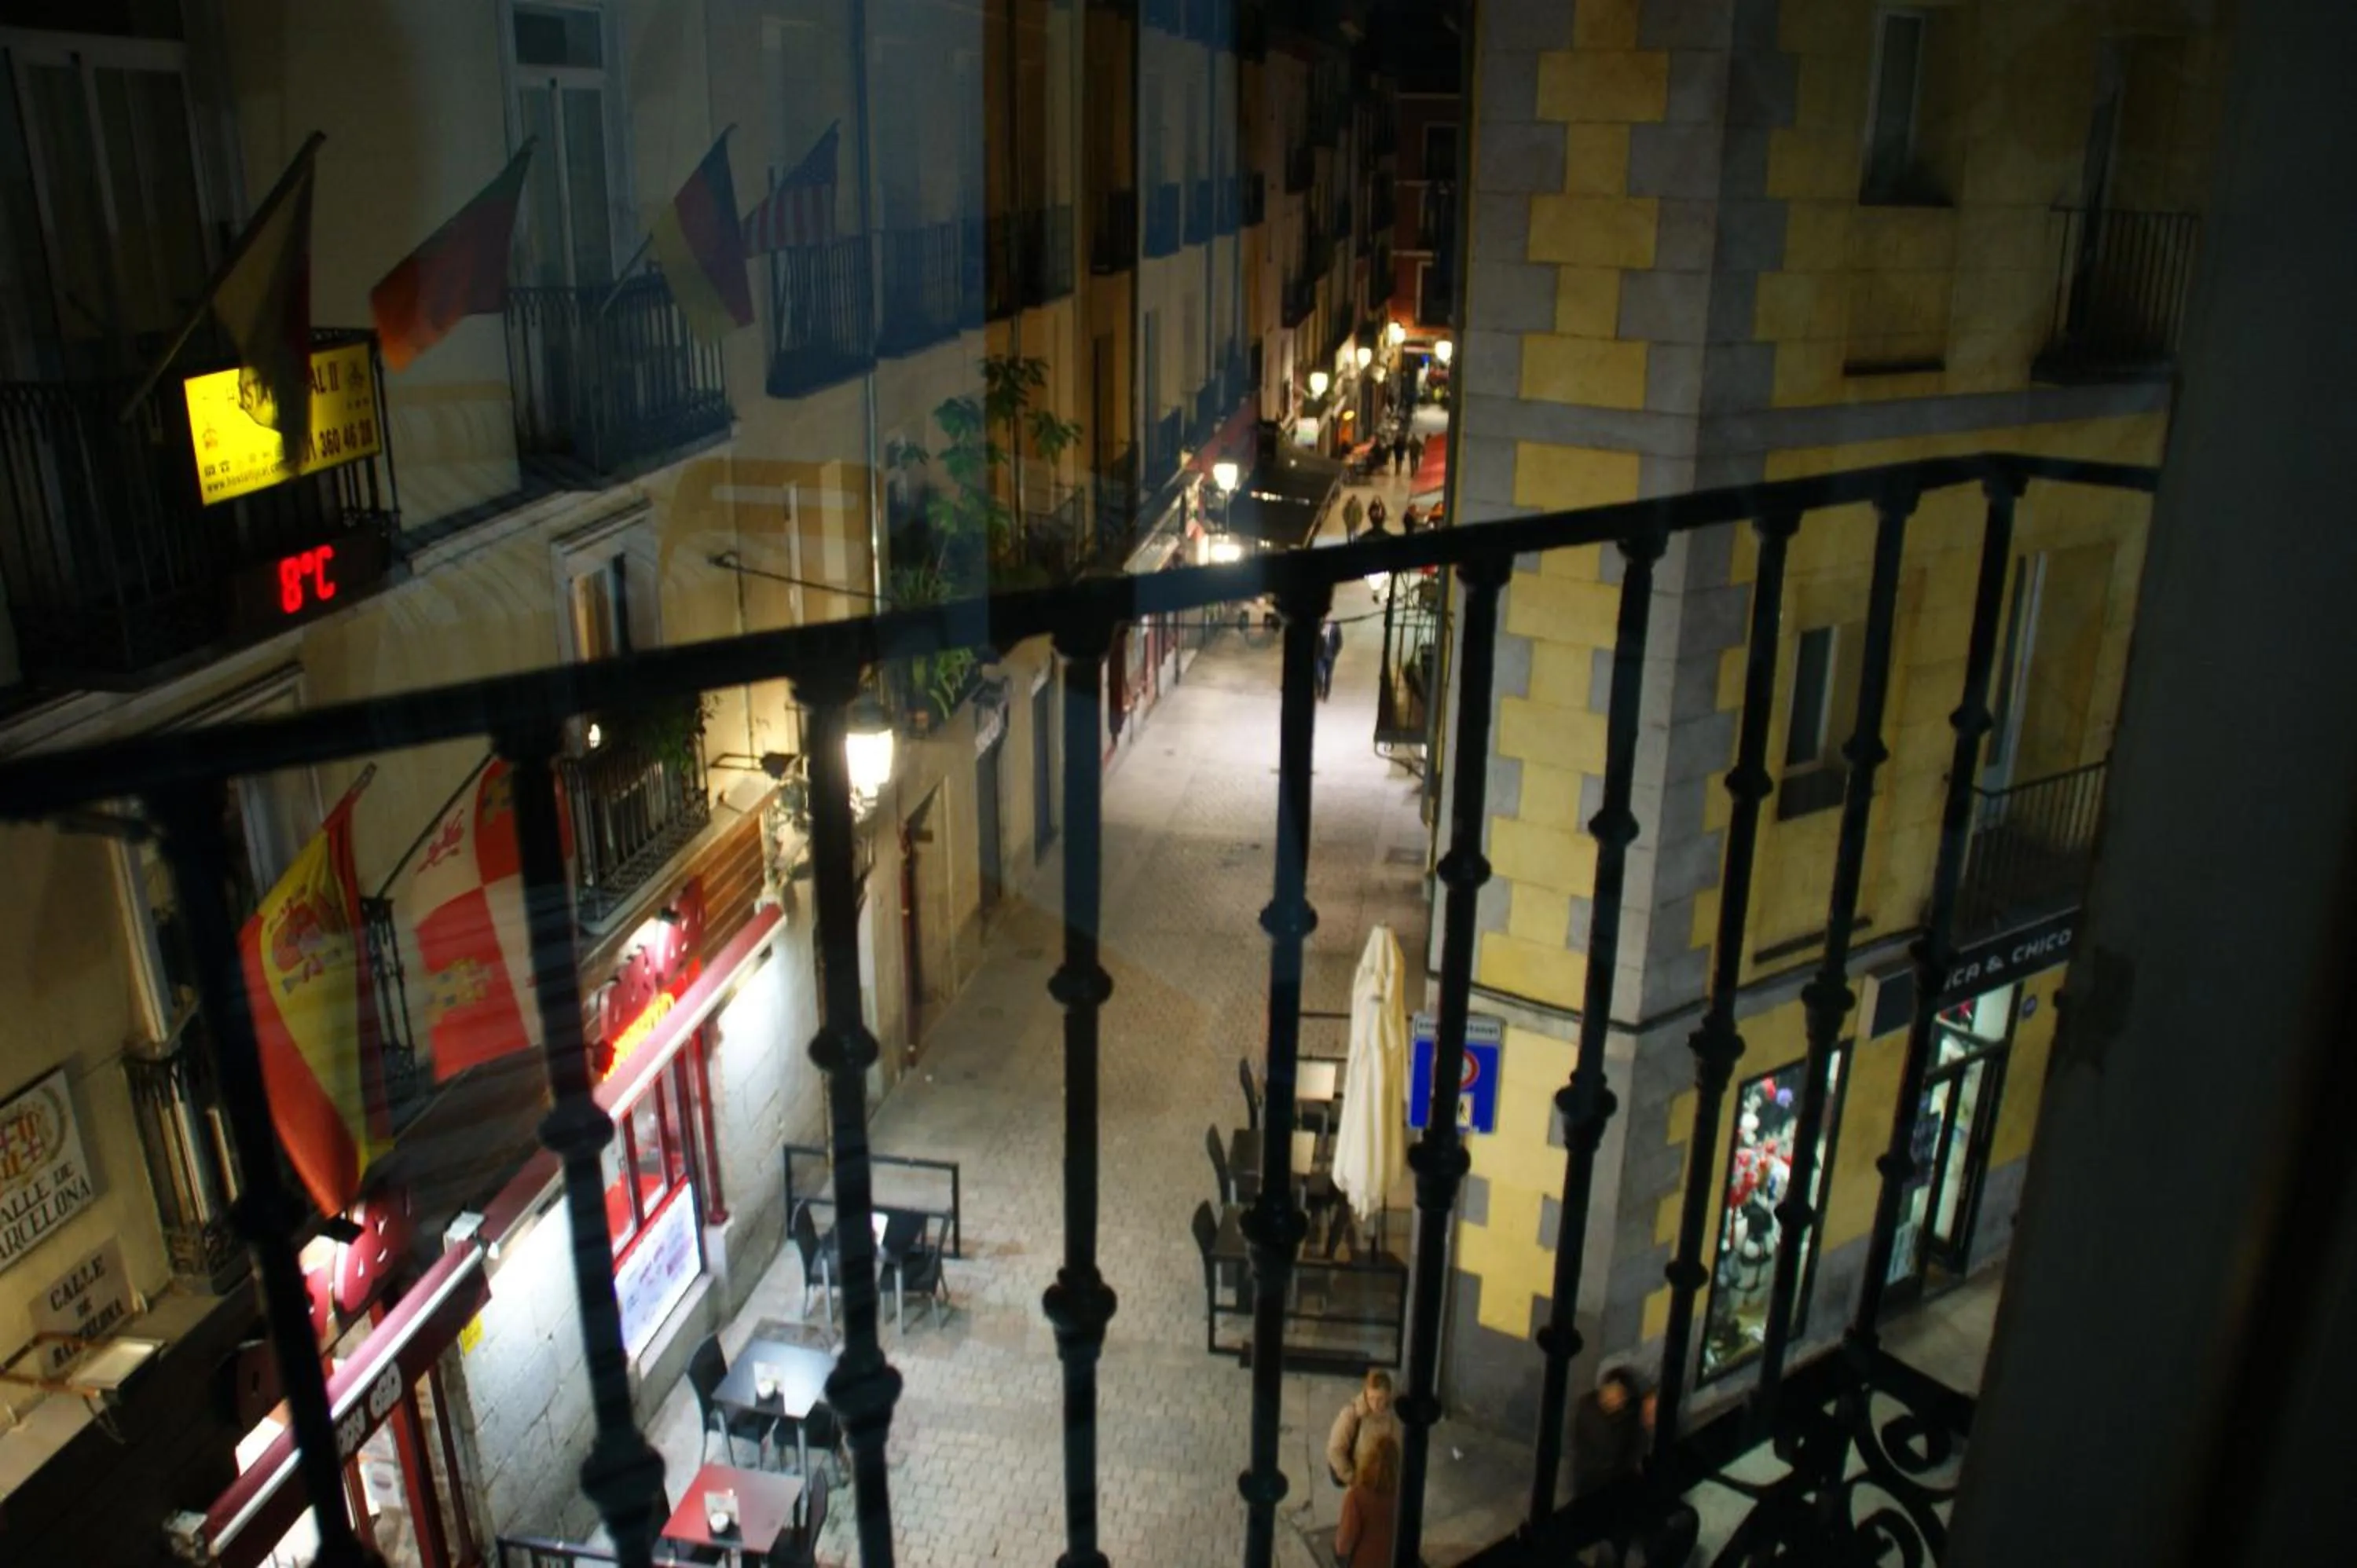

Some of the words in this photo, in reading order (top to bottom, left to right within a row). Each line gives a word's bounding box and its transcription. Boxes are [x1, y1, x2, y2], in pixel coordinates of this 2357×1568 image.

[1943, 961, 1981, 992] ICA
[1985, 954, 2006, 974] &
[2011, 927, 2073, 964] CHICO
[0, 1178, 51, 1229] ALLE
[0, 1174, 92, 1260] RCELONA
[50, 1253, 106, 1312] CALLE
